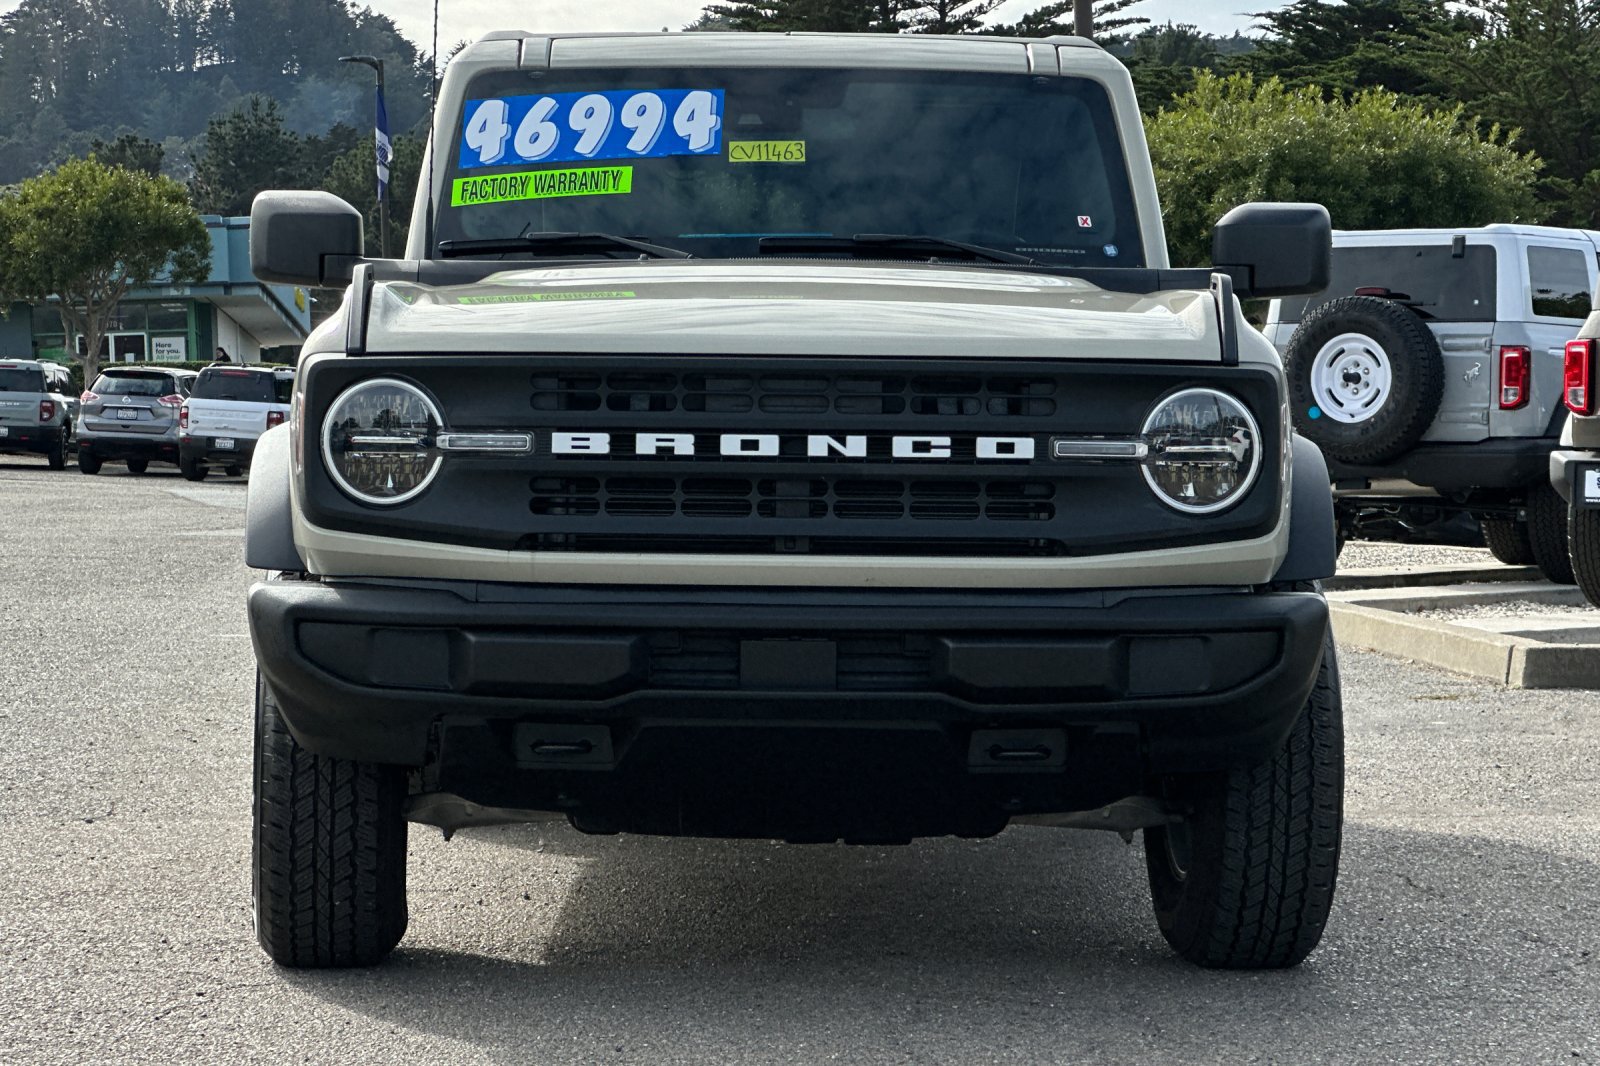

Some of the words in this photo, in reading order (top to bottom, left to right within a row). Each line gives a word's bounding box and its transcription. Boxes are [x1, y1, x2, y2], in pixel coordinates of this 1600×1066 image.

[465, 90, 720, 164] 46994
[730, 142, 804, 161] CV11463
[461, 175, 531, 202] FACTORY
[534, 169, 623, 195] WARRANTY
[552, 432, 1035, 459] BRONCO
